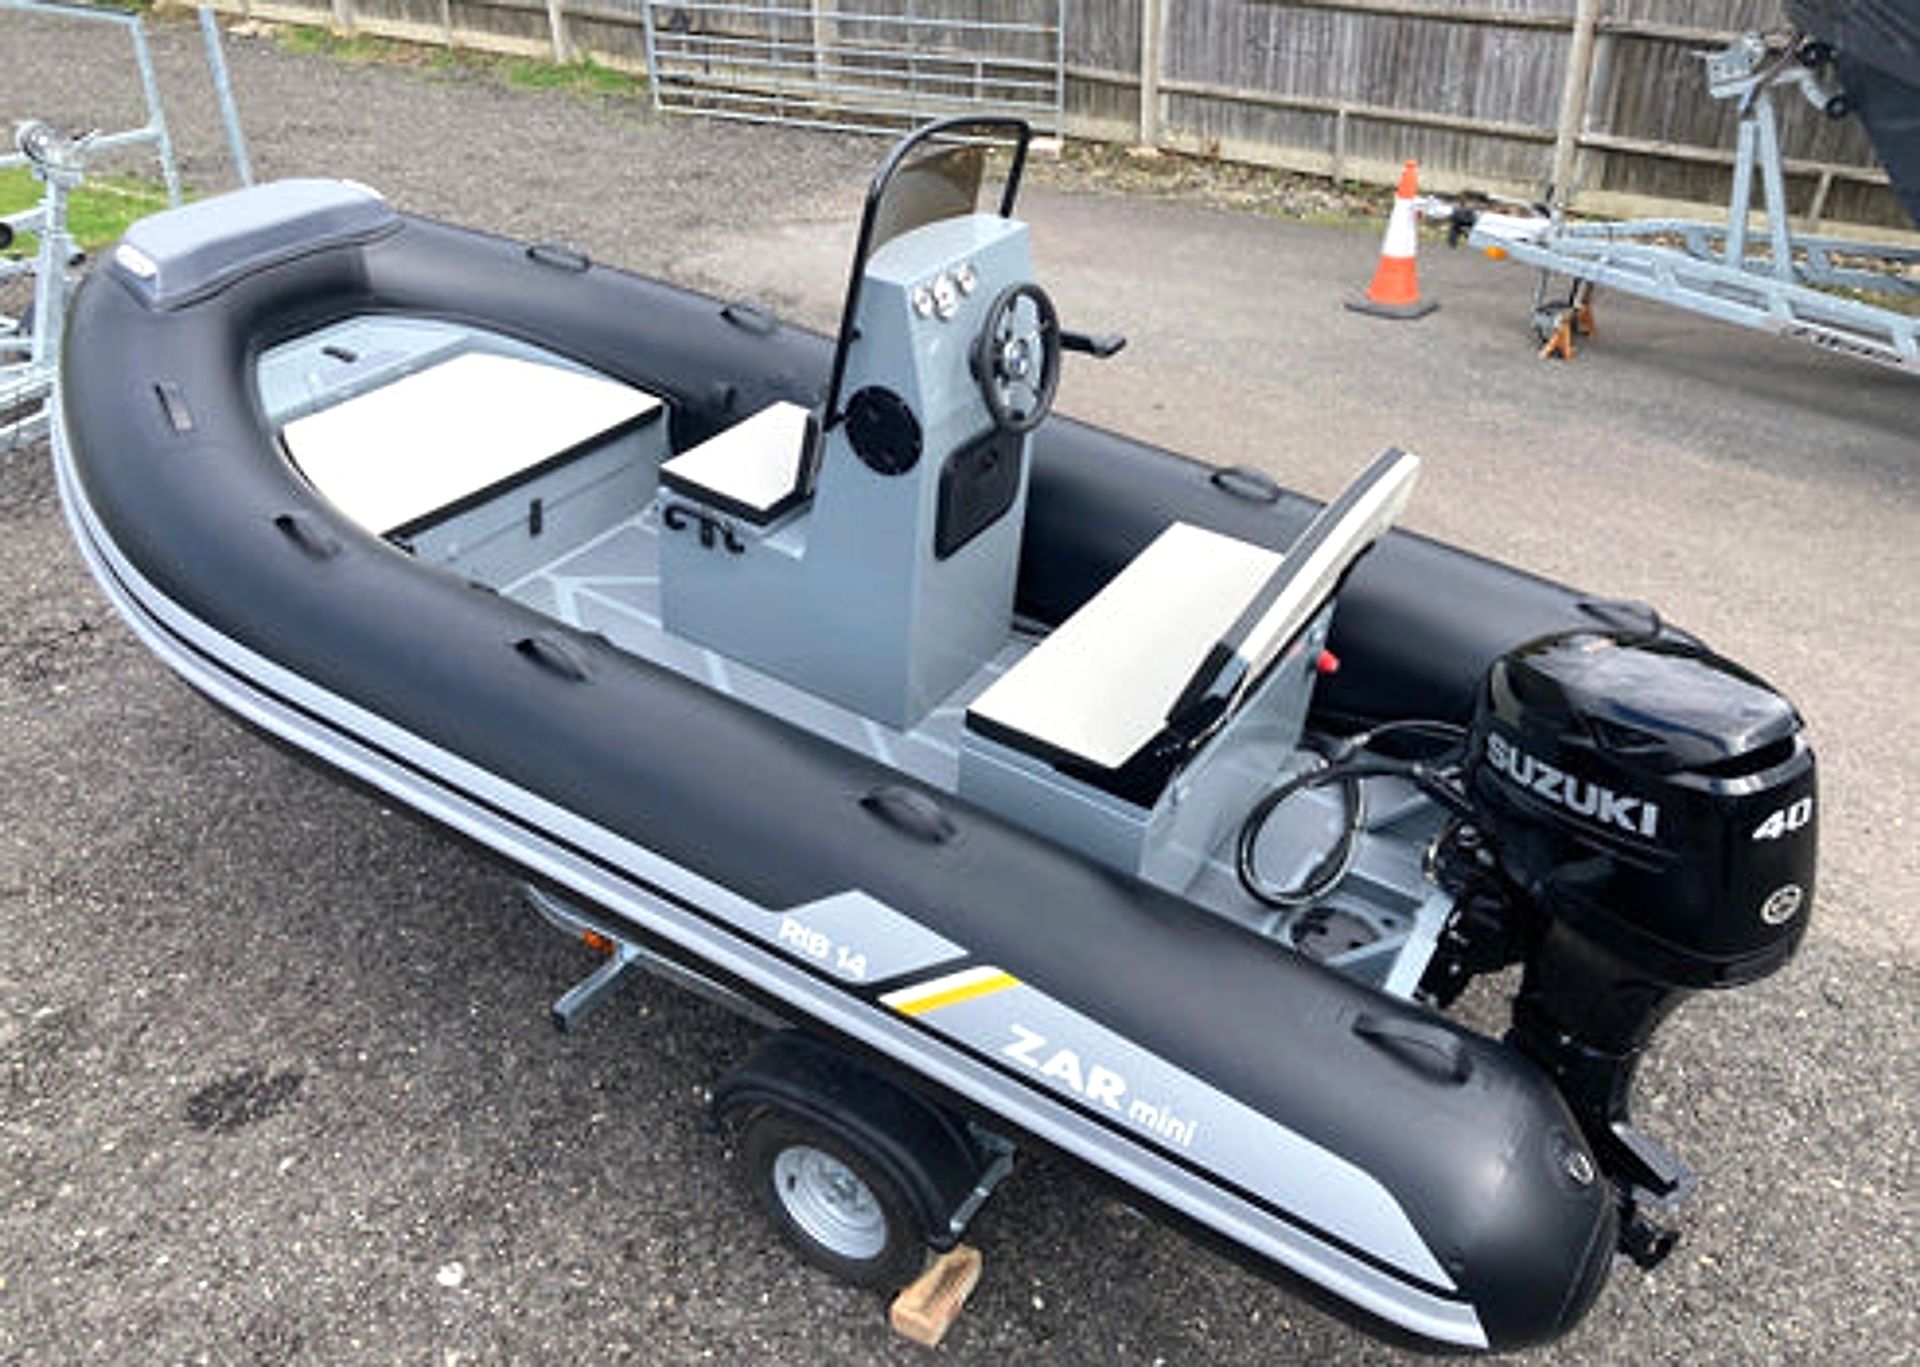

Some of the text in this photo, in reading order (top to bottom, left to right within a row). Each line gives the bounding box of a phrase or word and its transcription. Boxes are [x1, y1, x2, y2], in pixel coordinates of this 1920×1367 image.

[1487, 732, 1659, 838] SUZUKI
[1752, 798, 1813, 840] 40
[779, 917, 867, 978] RIB 14
[1005, 1024, 1198, 1148] ZAR mini
